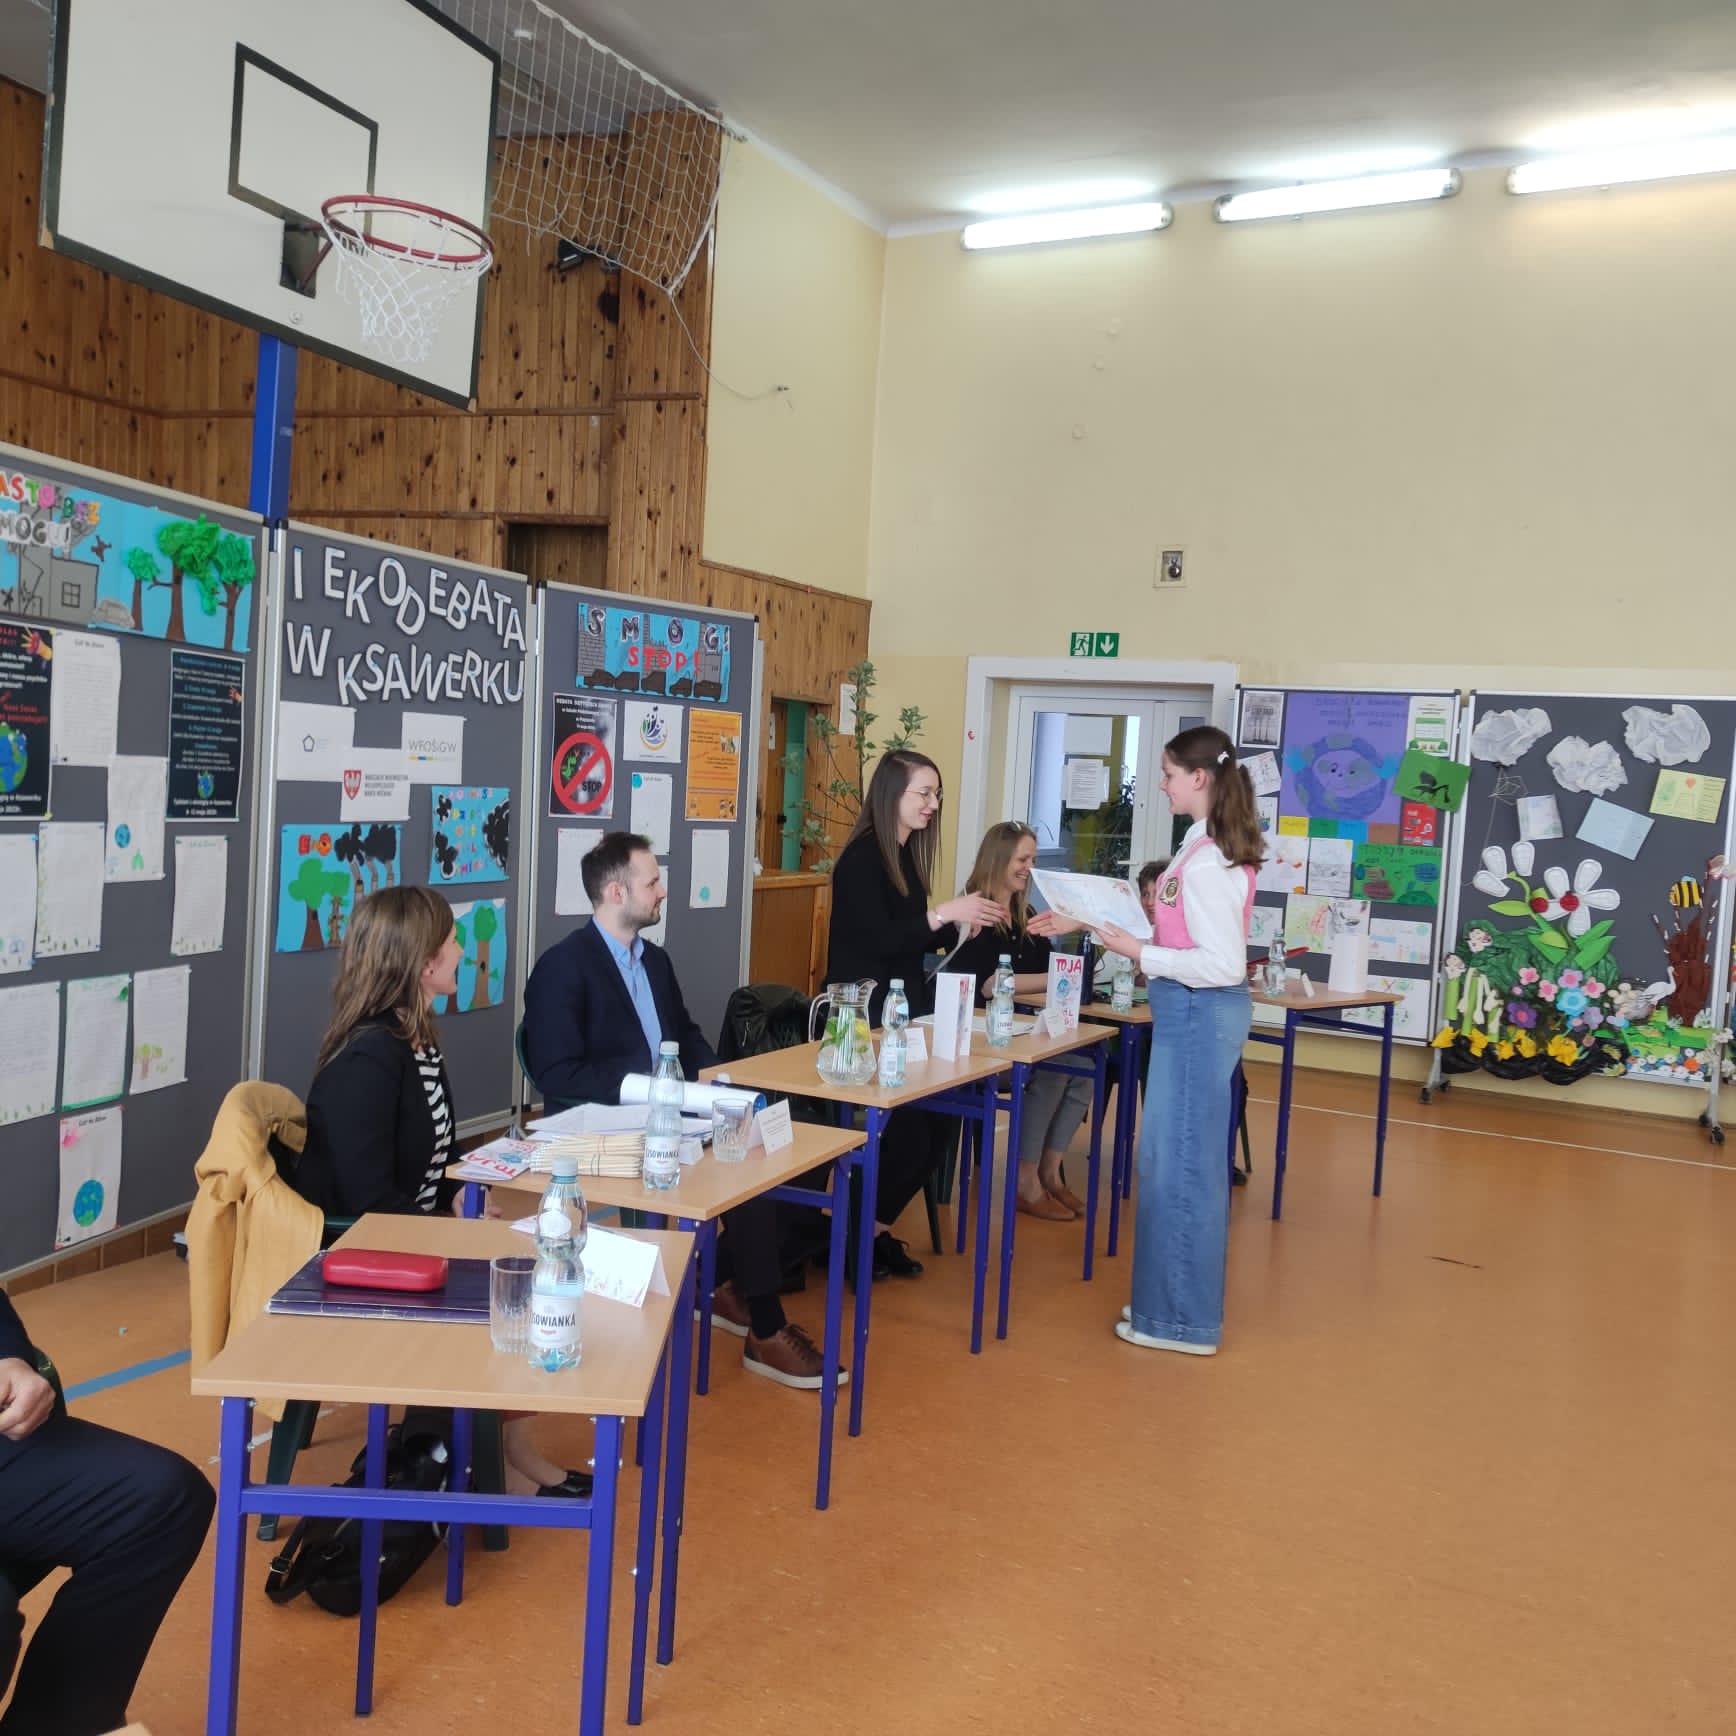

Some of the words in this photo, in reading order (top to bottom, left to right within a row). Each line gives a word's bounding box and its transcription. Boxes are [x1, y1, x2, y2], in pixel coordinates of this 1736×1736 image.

[293, 548, 303, 600] I
[324, 546, 527, 652] EKODEBATA
[286, 621, 332, 677] W
[337, 642, 526, 706] KSAWERKU
[627, 645, 700, 676] STOP!
[582, 780, 602, 792] STOP
